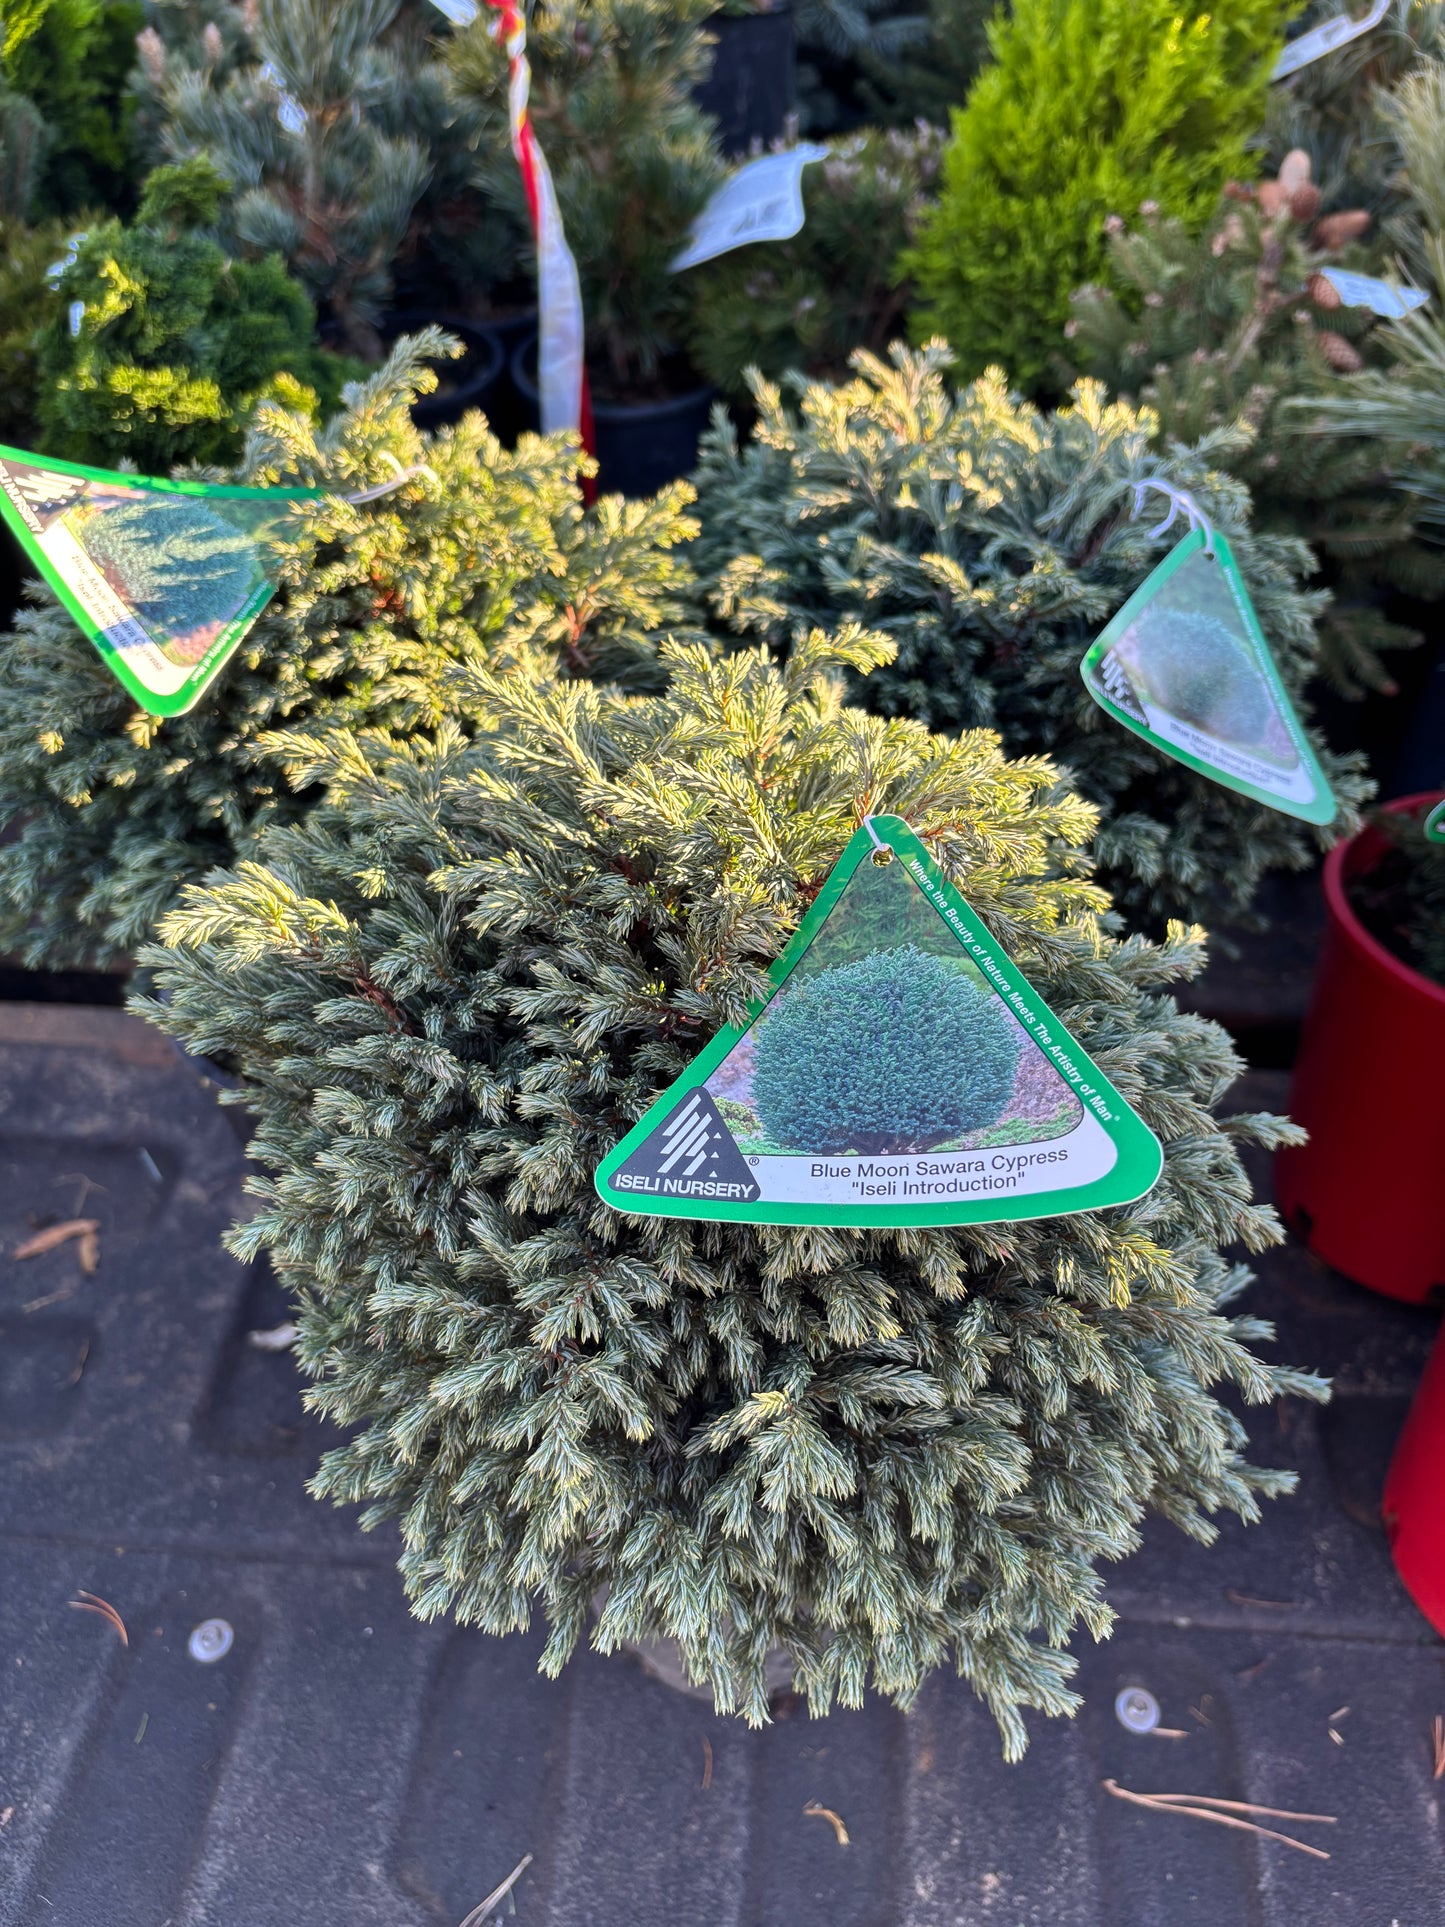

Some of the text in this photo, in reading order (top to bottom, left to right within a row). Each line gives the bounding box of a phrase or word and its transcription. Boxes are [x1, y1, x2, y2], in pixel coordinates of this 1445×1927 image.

[909, 859, 935, 890] Where
[932, 890, 948, 908] the
[945, 907, 975, 943] Beauty
[972, 945, 987, 955] of
[981, 956, 1011, 991] Nature
[1008, 992, 1036, 1024] Meets
[1034, 1023, 1052, 1044] The
[1048, 1045, 1083, 1083] Artistry
[1080, 1084, 1096, 1096] of
[811, 1149, 1068, 1178] Blue Moon Sawara Cypress
[615, 1174, 755, 1199] ISELI NURSERY
[852, 1171, 1025, 1196] "Iseli Introduction"
